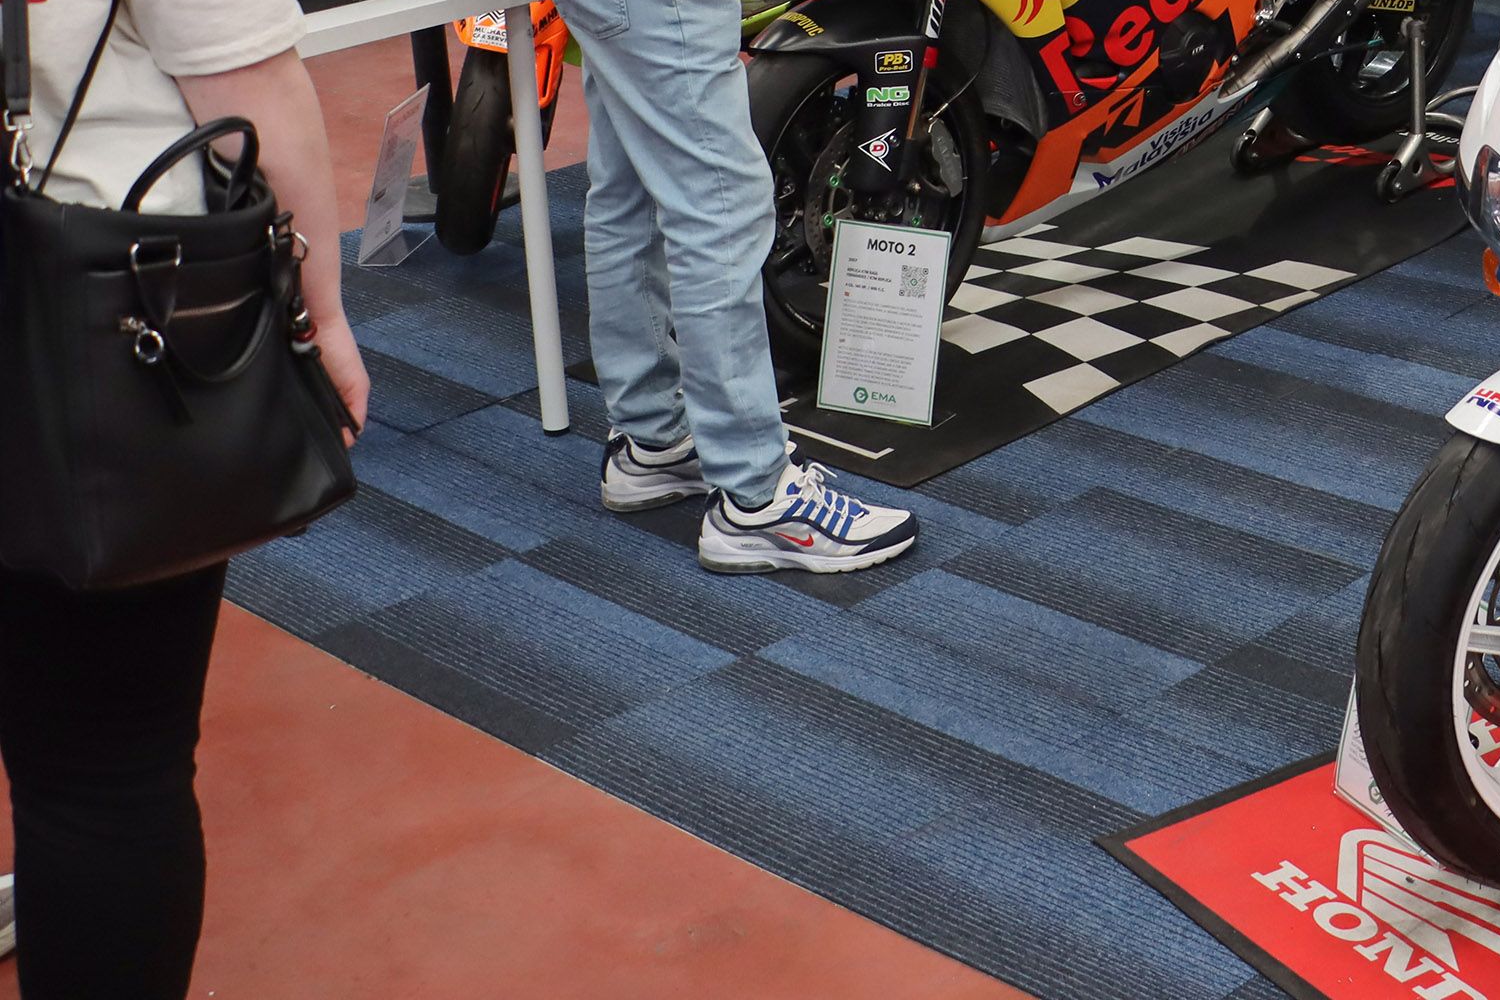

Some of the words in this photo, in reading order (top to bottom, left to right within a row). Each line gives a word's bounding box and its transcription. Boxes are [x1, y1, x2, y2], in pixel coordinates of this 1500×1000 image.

[883, 52, 904, 66] PB
[879, 64, 908, 72] Pro-Bolt
[866, 86, 910, 103] NG
[1092, 107, 1216, 190] Malaysia
[867, 238, 904, 255] MOTO
[907, 244, 916, 257] 2
[871, 391, 897, 404] EMA
